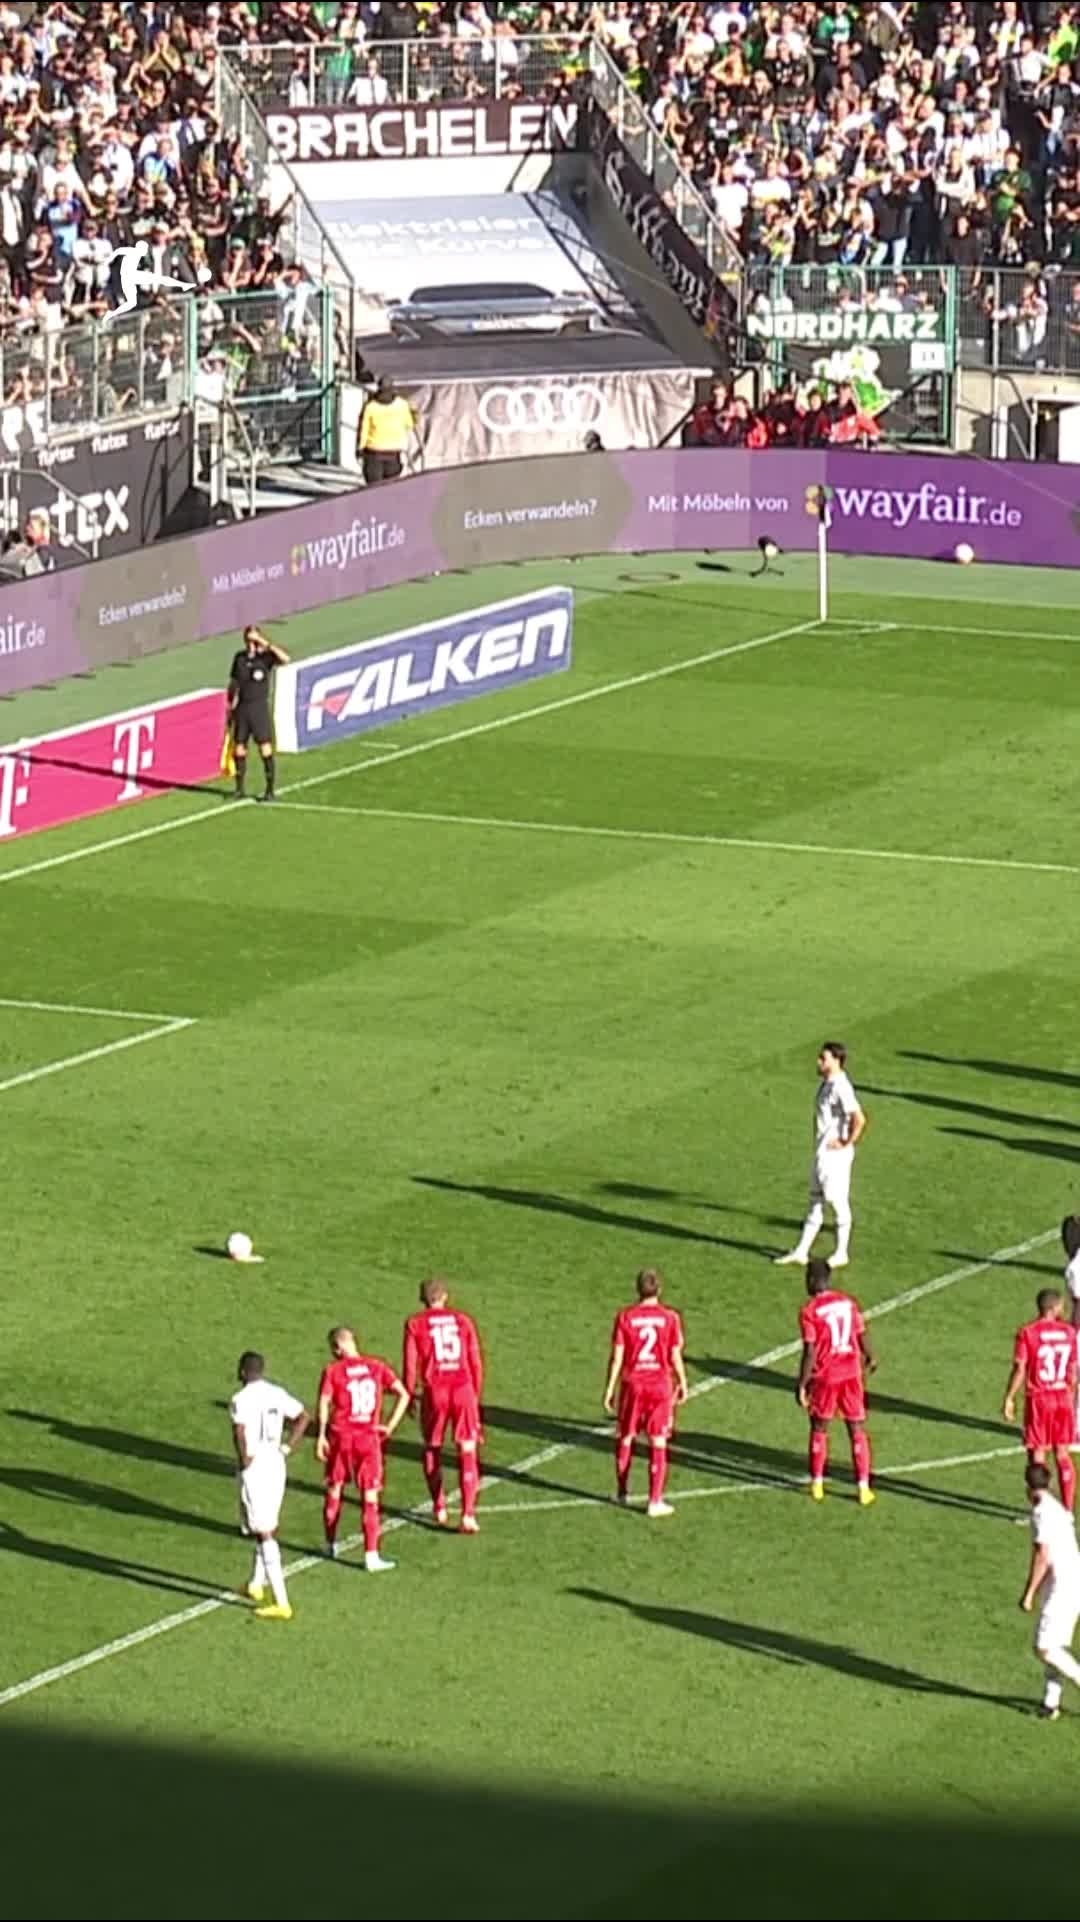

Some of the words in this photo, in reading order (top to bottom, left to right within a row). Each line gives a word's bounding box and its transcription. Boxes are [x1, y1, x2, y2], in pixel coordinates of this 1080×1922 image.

[265, 104, 578, 162] BRACHELEN
[747, 312, 939, 339] NORDHARZ
[463, 510, 502, 529] Ecken
[505, 498, 598, 524] verwandeln?
[648, 495, 678, 512] Mit
[683, 491, 750, 512] Möbeln
[755, 497, 788, 512] von
[835, 482, 1022, 526] wayfair.de
[309, 516, 405, 570] wayfair.de
[99, 605, 128, 626] Ecken
[306, 608, 569, 731] FALKEN
[112, 714, 155, 801] T
[430, 1325, 461, 1362] 15
[638, 1327, 657, 1361] 2
[1038, 1343, 1071, 1381] 37
[347, 1378, 377, 1416] 18
